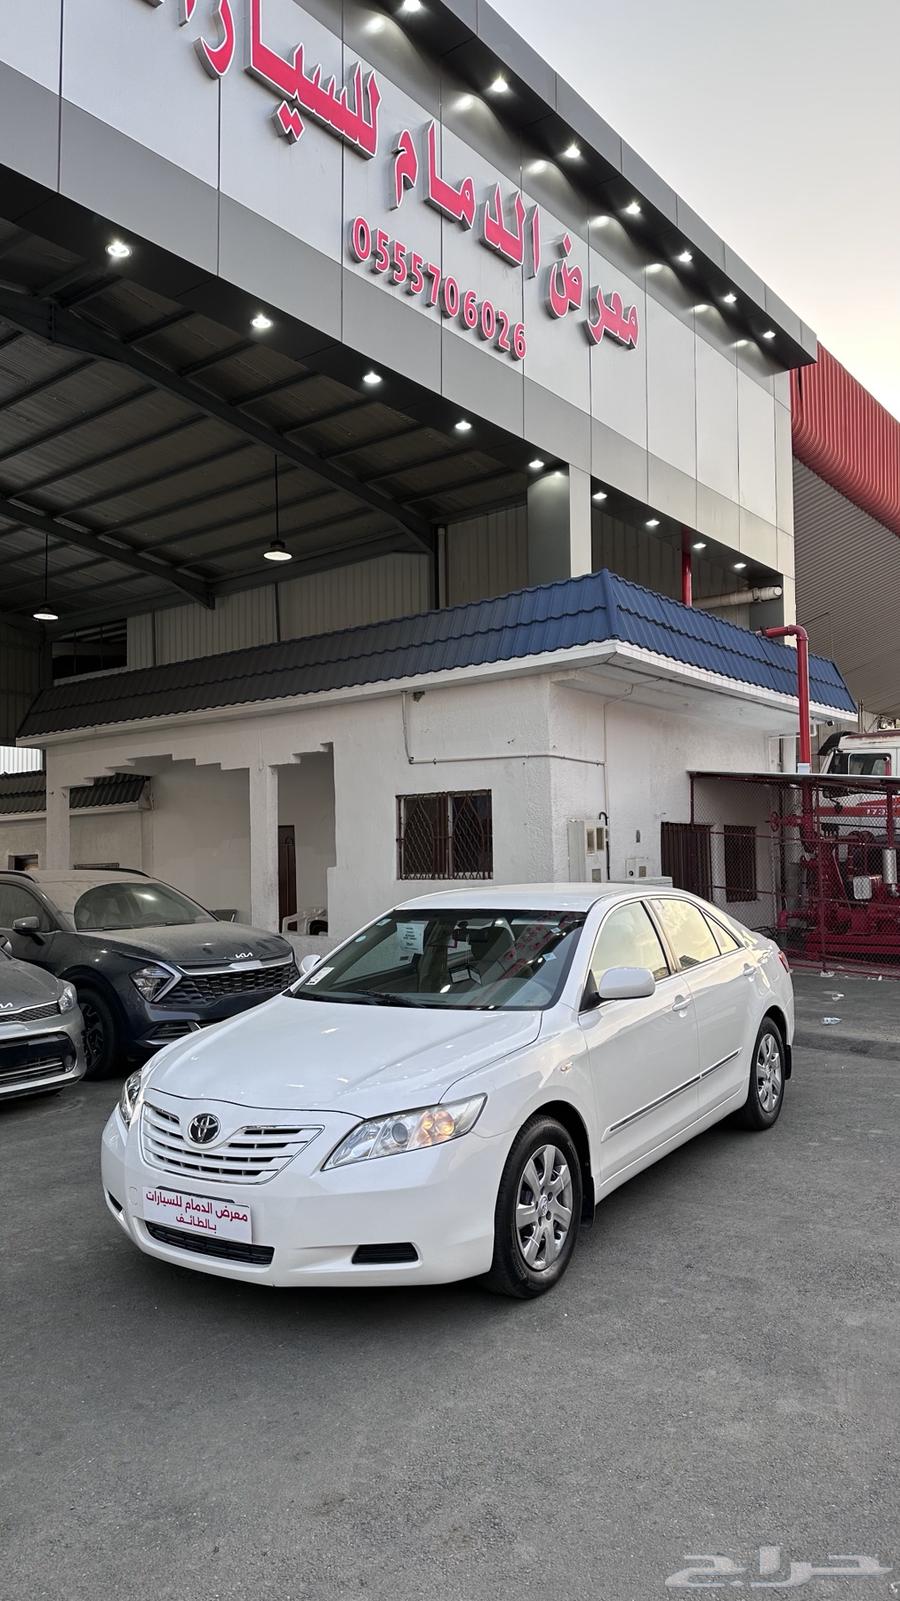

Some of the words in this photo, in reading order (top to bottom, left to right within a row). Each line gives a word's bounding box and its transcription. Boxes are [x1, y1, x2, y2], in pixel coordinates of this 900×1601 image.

[392, 119, 542, 278] الدمام
[350, 215, 528, 361] 0555706026
[547, 232, 640, 349] معرض
[145, 1190, 183, 1208] للسيارات
[184, 1198, 213, 1215] الدمام
[215, 1205, 248, 1222] معرض
